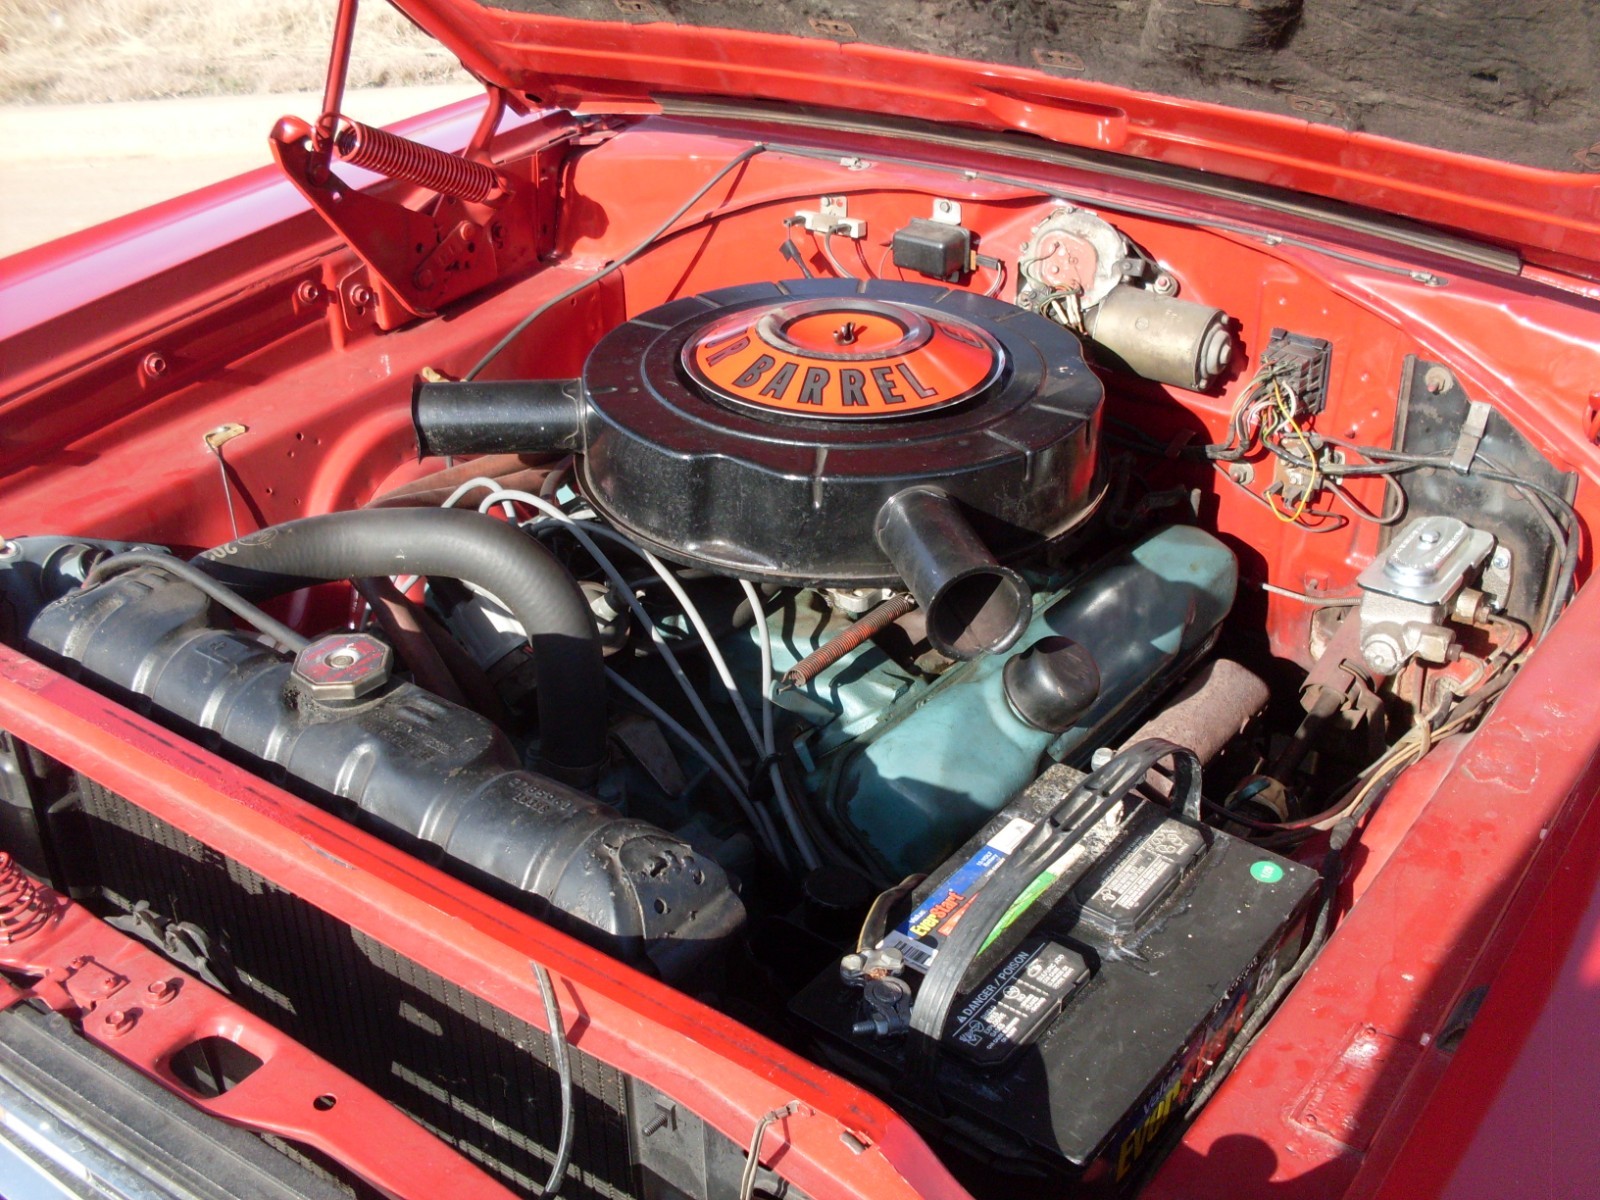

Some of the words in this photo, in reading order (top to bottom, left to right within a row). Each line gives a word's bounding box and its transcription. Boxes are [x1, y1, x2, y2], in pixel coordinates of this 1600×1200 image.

[732, 354, 938, 407] BARREL
[909, 890, 966, 937] EverStart
[963, 985, 997, 1015] DANGER
[998, 951, 1029, 980] POISON
